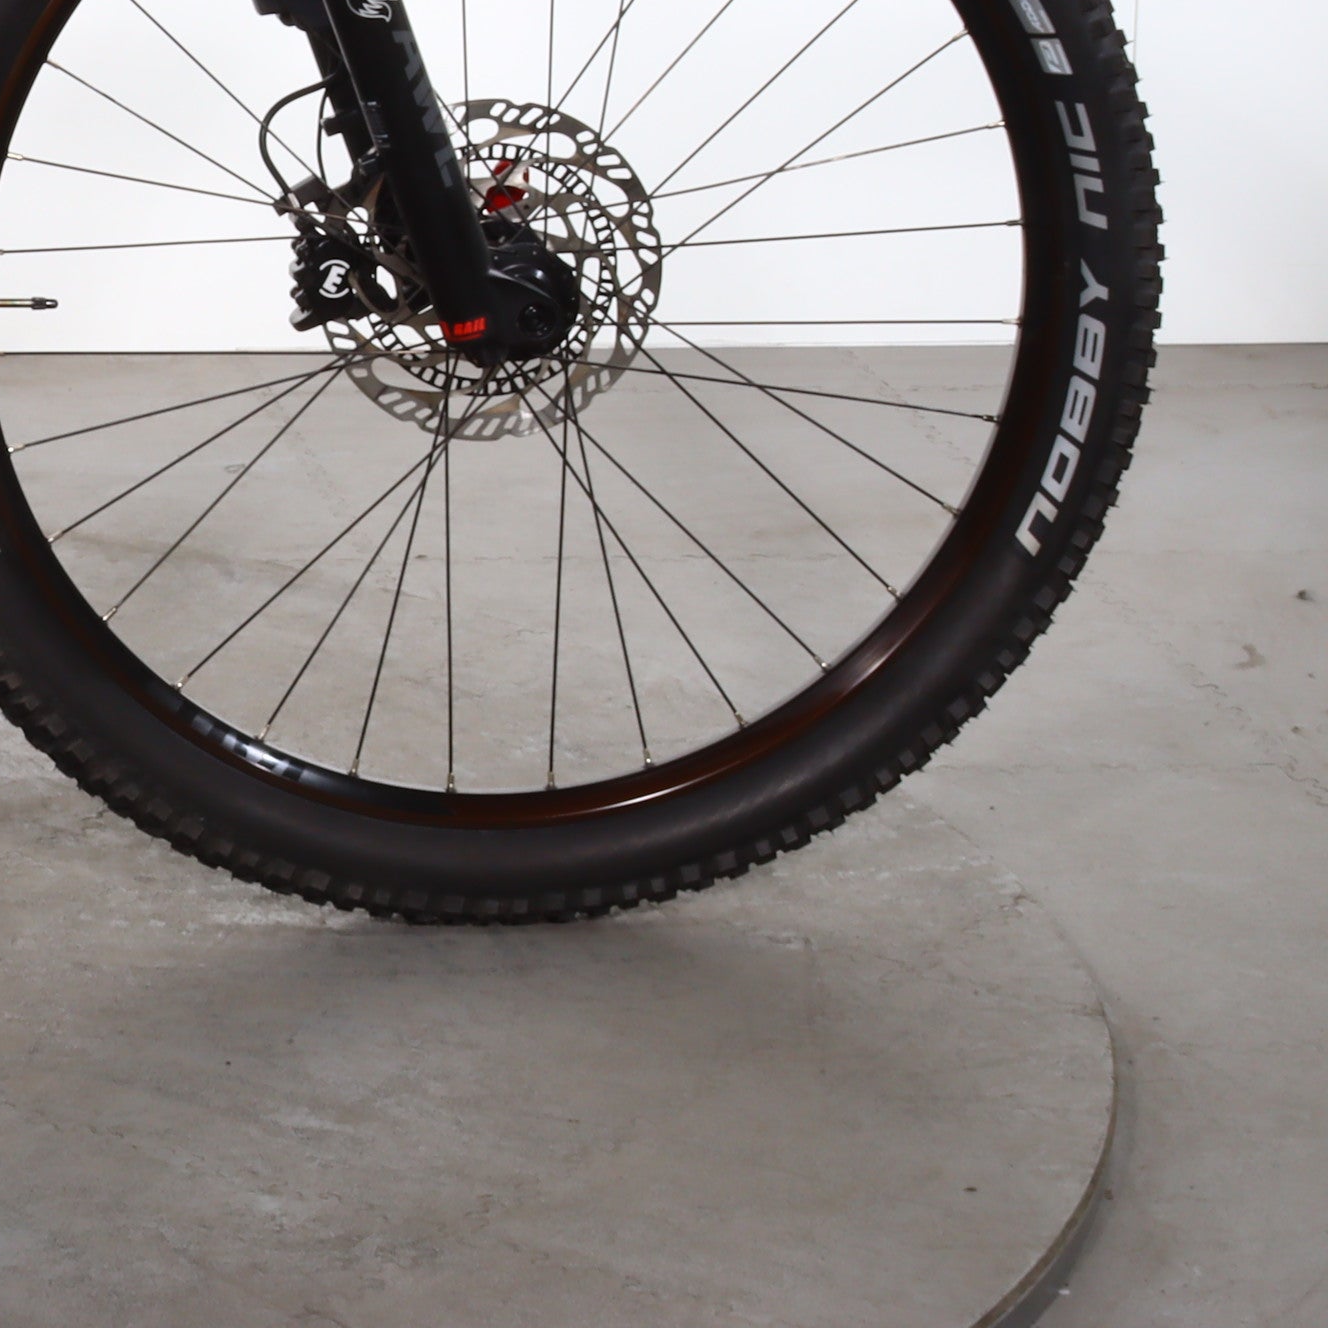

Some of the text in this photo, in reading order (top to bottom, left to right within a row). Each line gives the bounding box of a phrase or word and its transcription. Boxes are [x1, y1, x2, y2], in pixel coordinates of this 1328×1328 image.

[392, 29, 455, 188] AWL
[1014, 100, 1110, 557] NOBBY NIC
